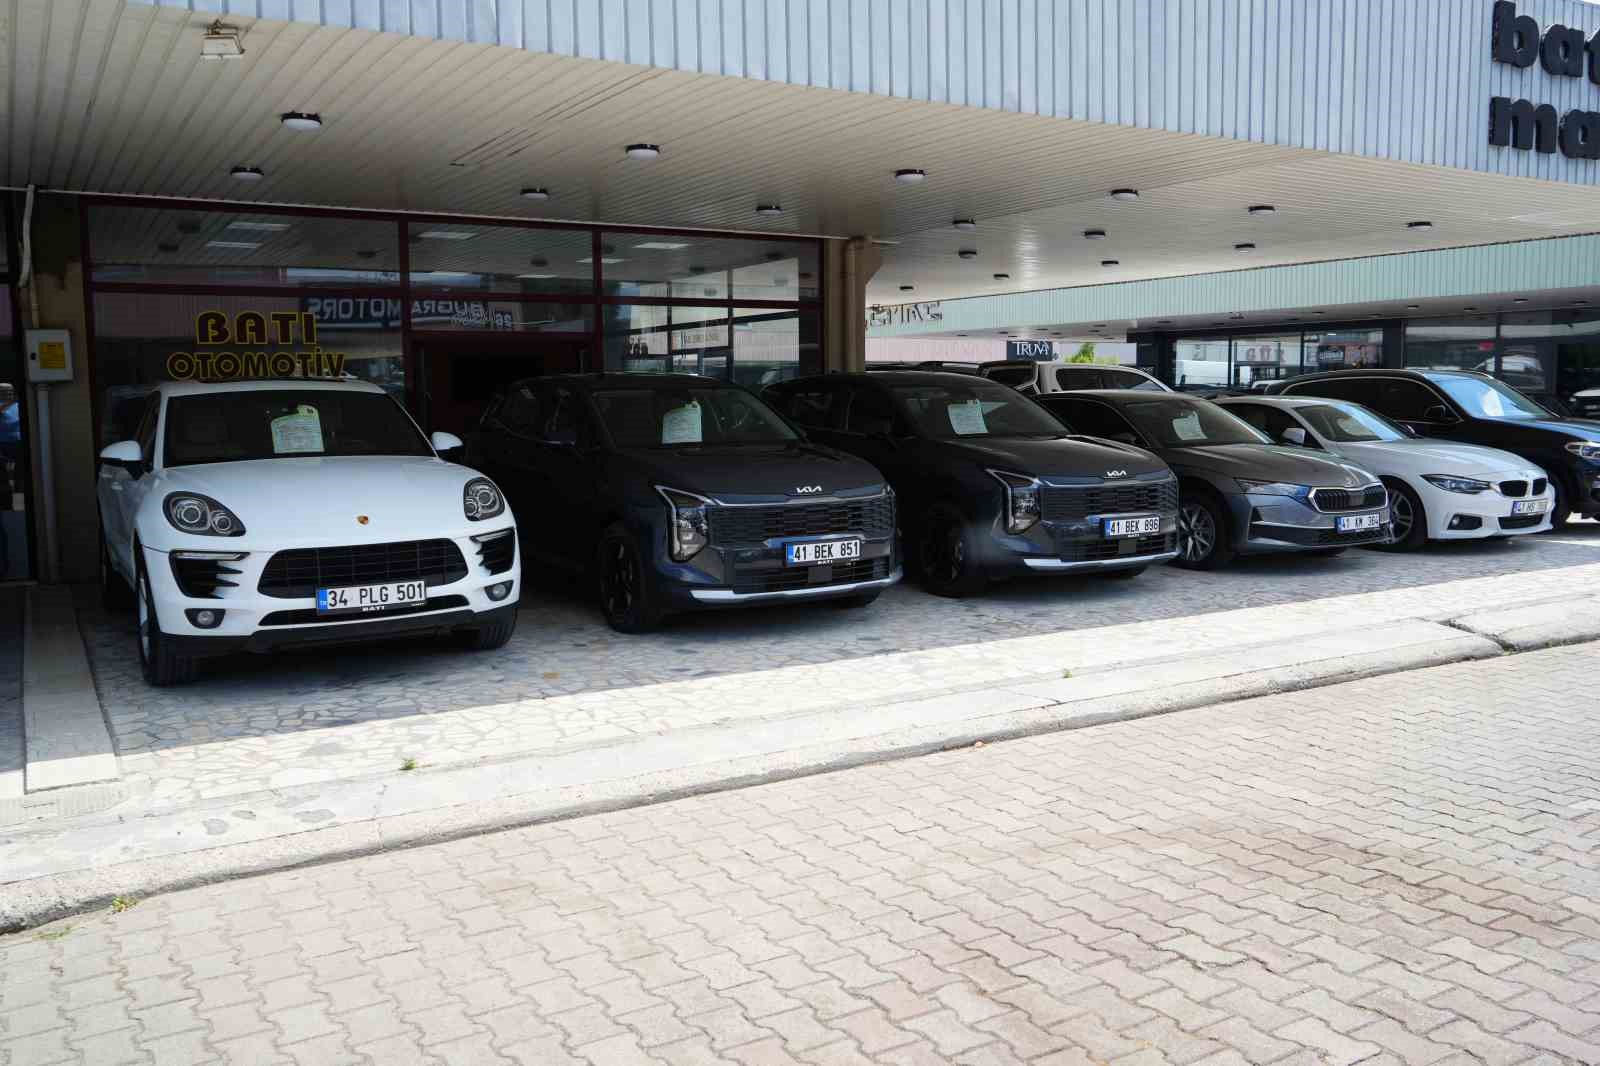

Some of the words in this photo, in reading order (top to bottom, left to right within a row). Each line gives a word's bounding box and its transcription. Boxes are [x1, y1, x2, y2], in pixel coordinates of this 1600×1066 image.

[196, 311, 318, 345] BATI
[167, 346, 346, 380] OTOMOTİV
[1110, 520, 1121, 534] 41
[1125, 519, 1140, 533] BEK
[794, 545, 807, 560] 41
[814, 543, 834, 559] BEK
[840, 541, 859, 557] 851
[328, 590, 348, 607] 34
[359, 586, 389, 604] PLG
[396, 583, 423, 601] 501
